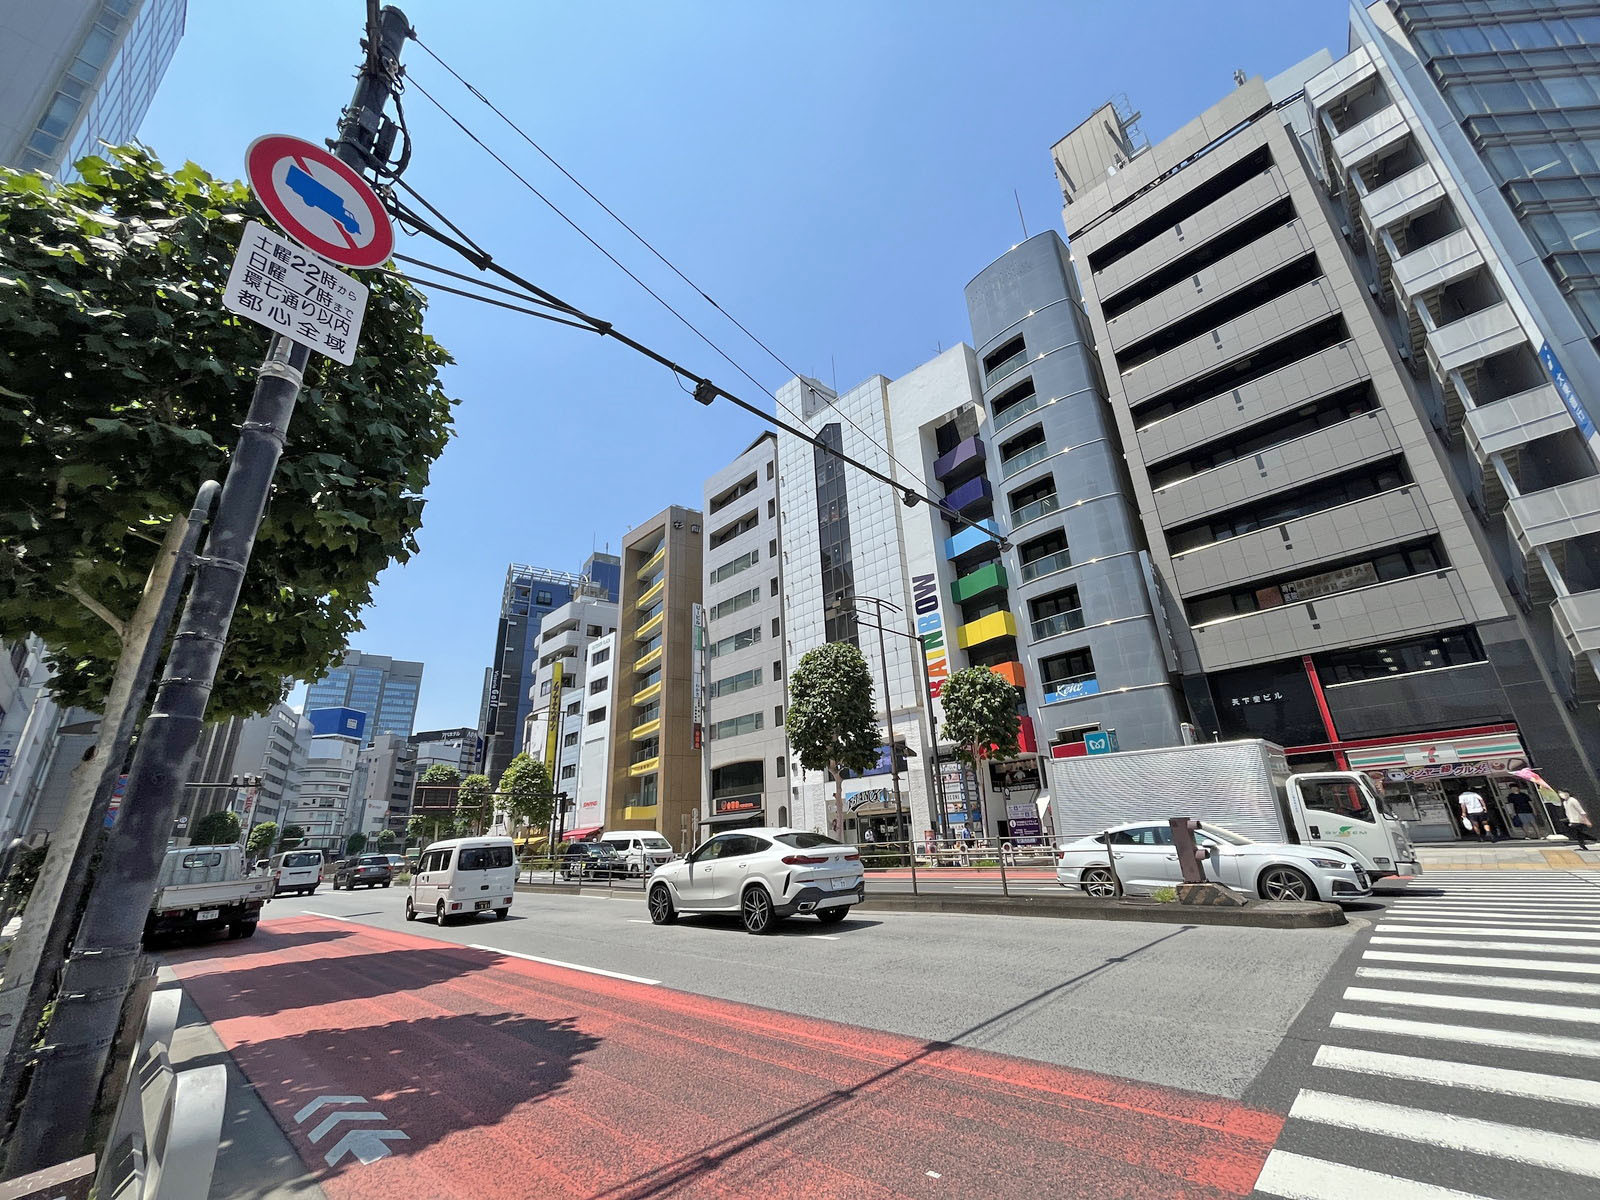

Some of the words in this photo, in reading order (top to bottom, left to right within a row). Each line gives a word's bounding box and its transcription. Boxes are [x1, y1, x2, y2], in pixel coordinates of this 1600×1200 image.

[252, 234, 358, 302] 土曜22時から
[236, 288, 347, 355] 都心全域
[240, 269, 351, 338] 環七通り以内
